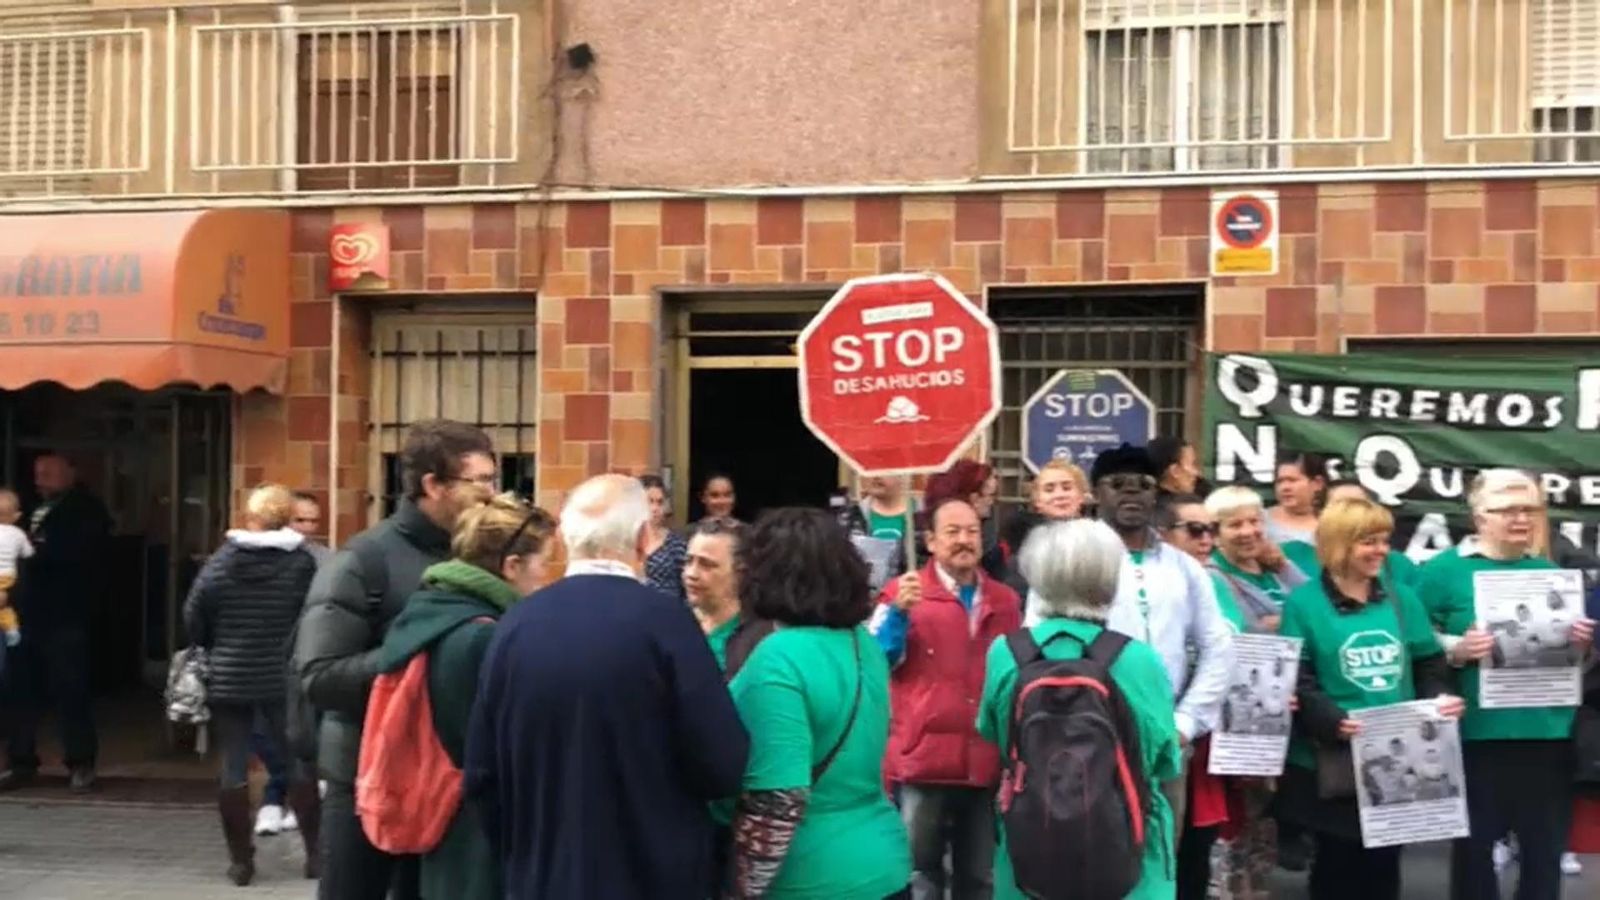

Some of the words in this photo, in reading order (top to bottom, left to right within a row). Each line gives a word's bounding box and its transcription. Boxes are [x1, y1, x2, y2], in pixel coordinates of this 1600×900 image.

[832, 326, 964, 373] STOP
[833, 369, 965, 395] DESAHUCIOS
[1217, 354, 1564, 427] QUEREMOS
[1044, 393, 1133, 418] STOP
[1346, 643, 1400, 668] STOP
